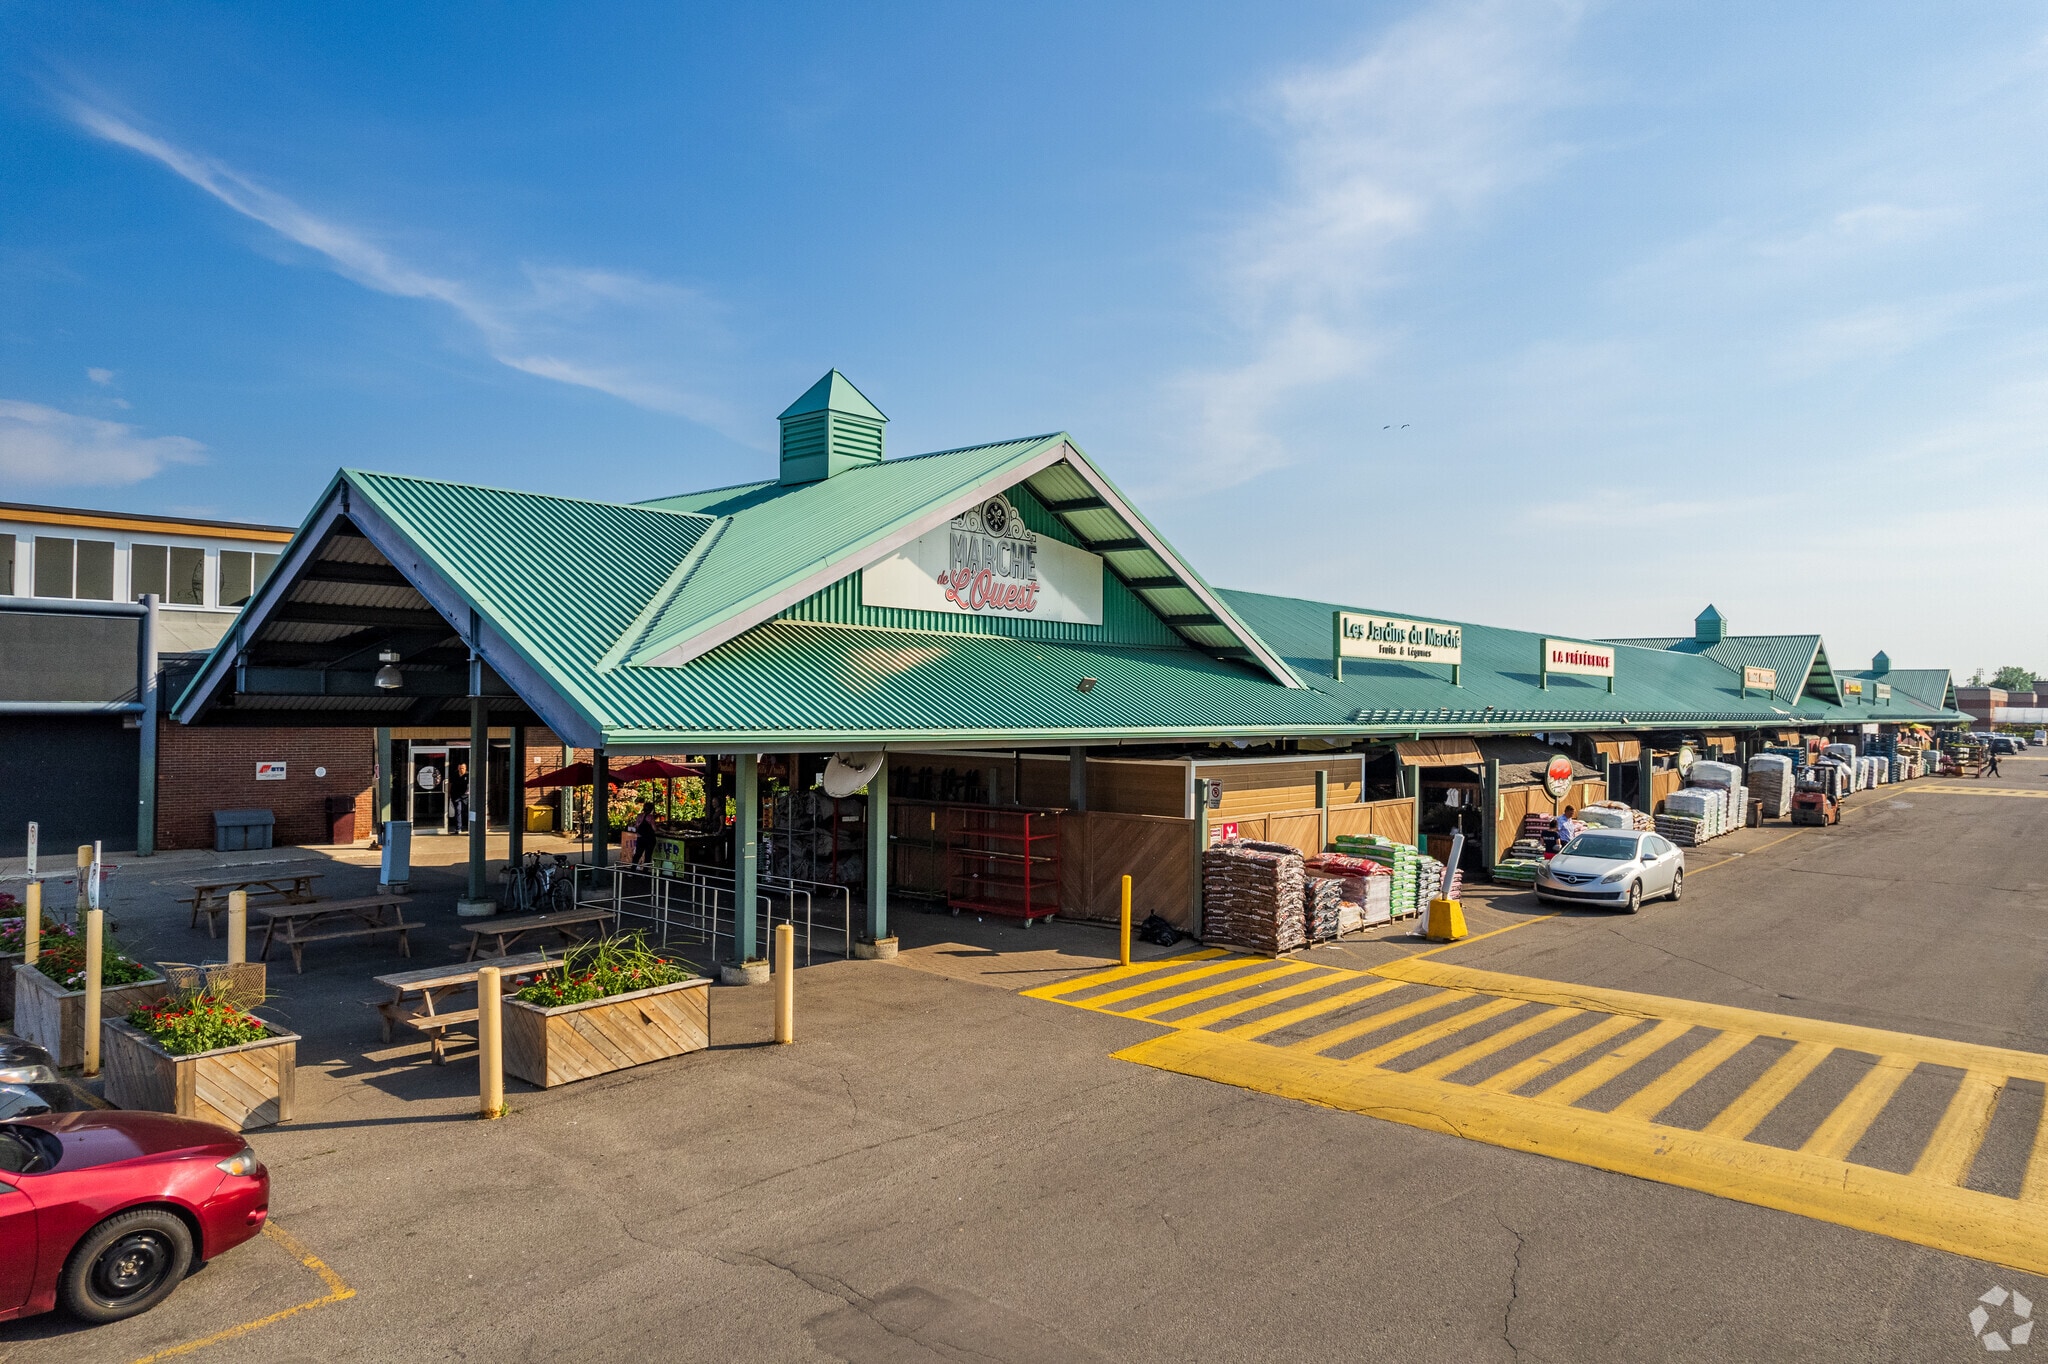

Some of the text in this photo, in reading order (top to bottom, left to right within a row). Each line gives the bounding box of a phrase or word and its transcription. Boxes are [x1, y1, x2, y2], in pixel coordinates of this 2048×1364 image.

[937, 567, 1040, 612] de L'Ouest
[1343, 617, 1461, 648] Les Jardins du Marché
[1378, 644, 1431, 659] Fruits & Légumes
[1553, 650, 1564, 662] LA
